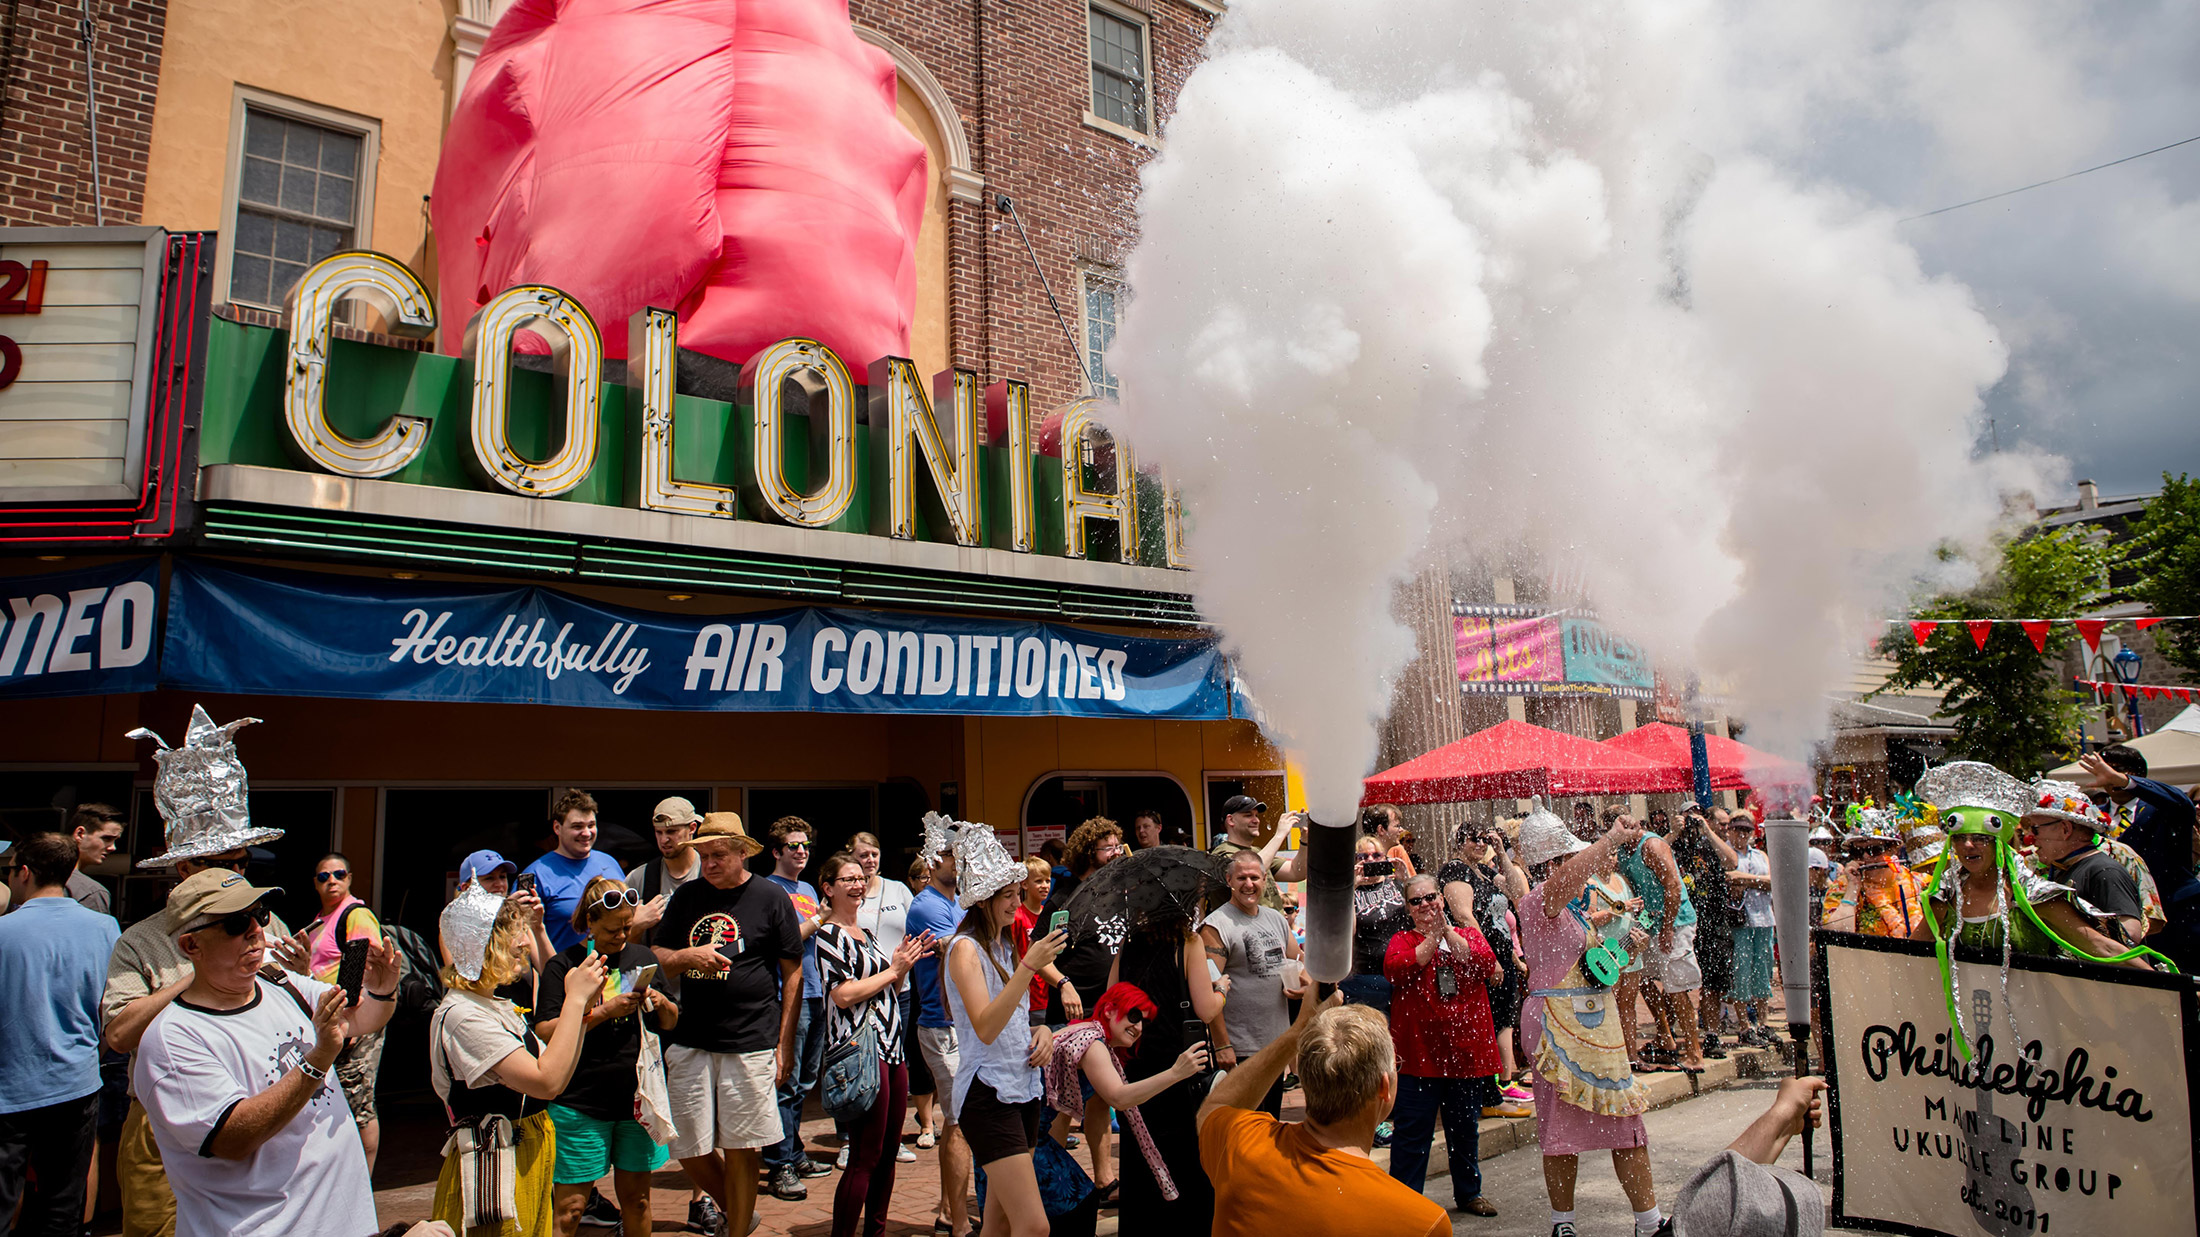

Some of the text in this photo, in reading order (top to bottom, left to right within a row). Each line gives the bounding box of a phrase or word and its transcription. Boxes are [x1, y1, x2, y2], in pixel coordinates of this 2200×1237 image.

[0, 581, 154, 676] NED
[390, 608, 1128, 701] Healthfully AIR CONDITIONED
[1614, 663, 1649, 682] HEART
[1861, 1021, 2153, 1123] Philadelphia
[2000, 1117, 2074, 1155] LINE
[1960, 1179, 2050, 1234] est. 2011
[2010, 1159, 2122, 1200] GROUP
